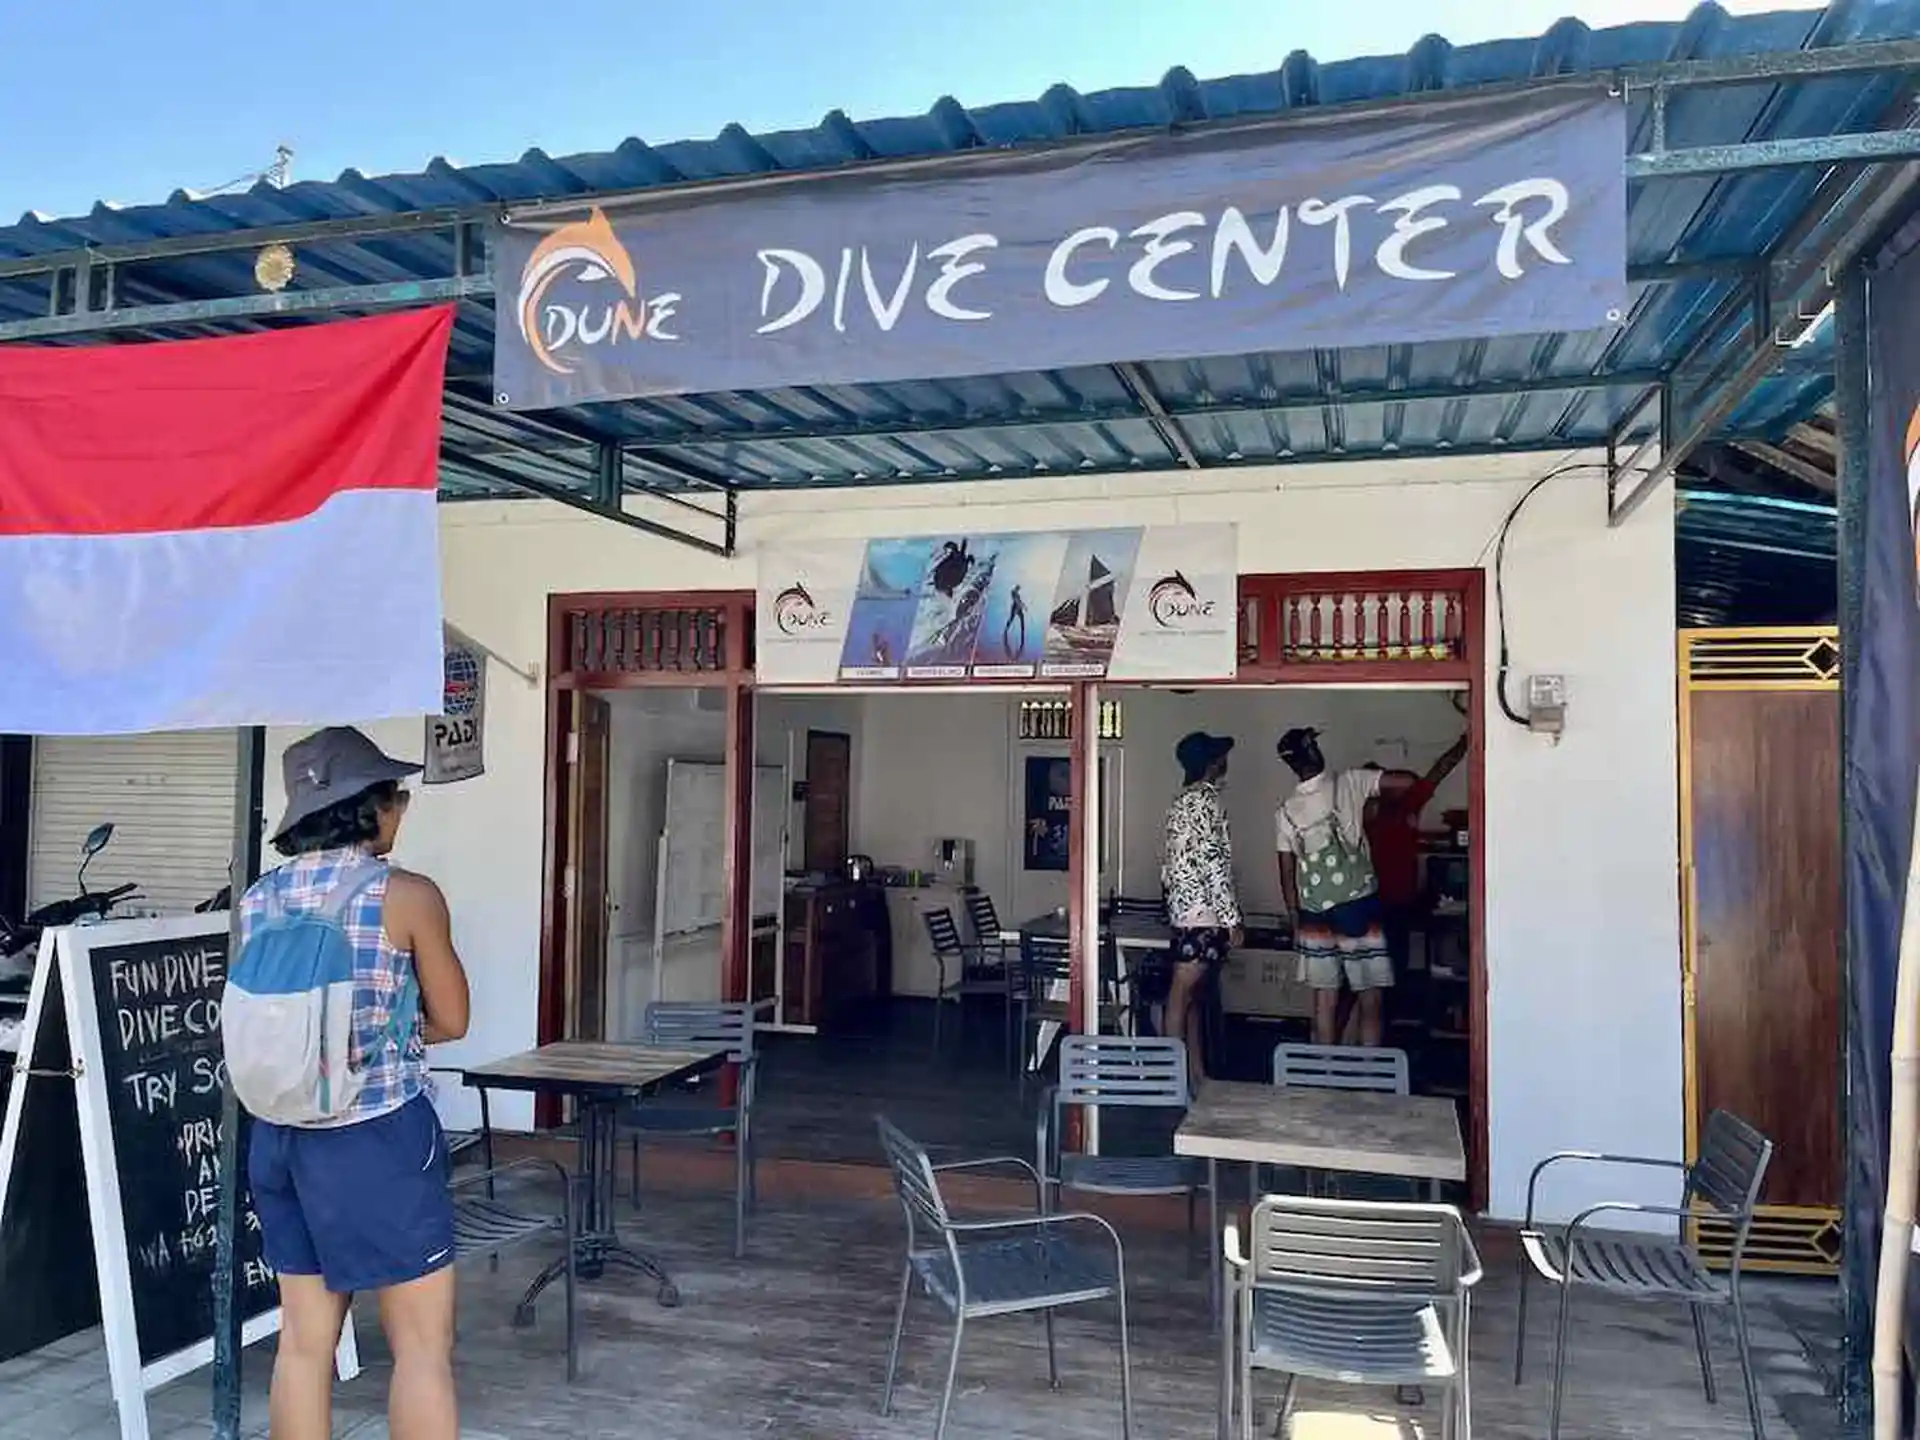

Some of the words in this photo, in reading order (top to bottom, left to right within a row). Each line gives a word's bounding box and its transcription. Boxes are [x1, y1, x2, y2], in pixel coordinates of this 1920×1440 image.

[756, 233, 999, 334] DIVE
[1044, 177, 1573, 307] CENTER
[544, 292, 683, 352] DUNE
[109, 959, 159, 1000] FUN
[163, 949, 226, 998] DIVE
[117, 1003, 181, 1051] DIVE
[122, 1069, 178, 1114] TRY
